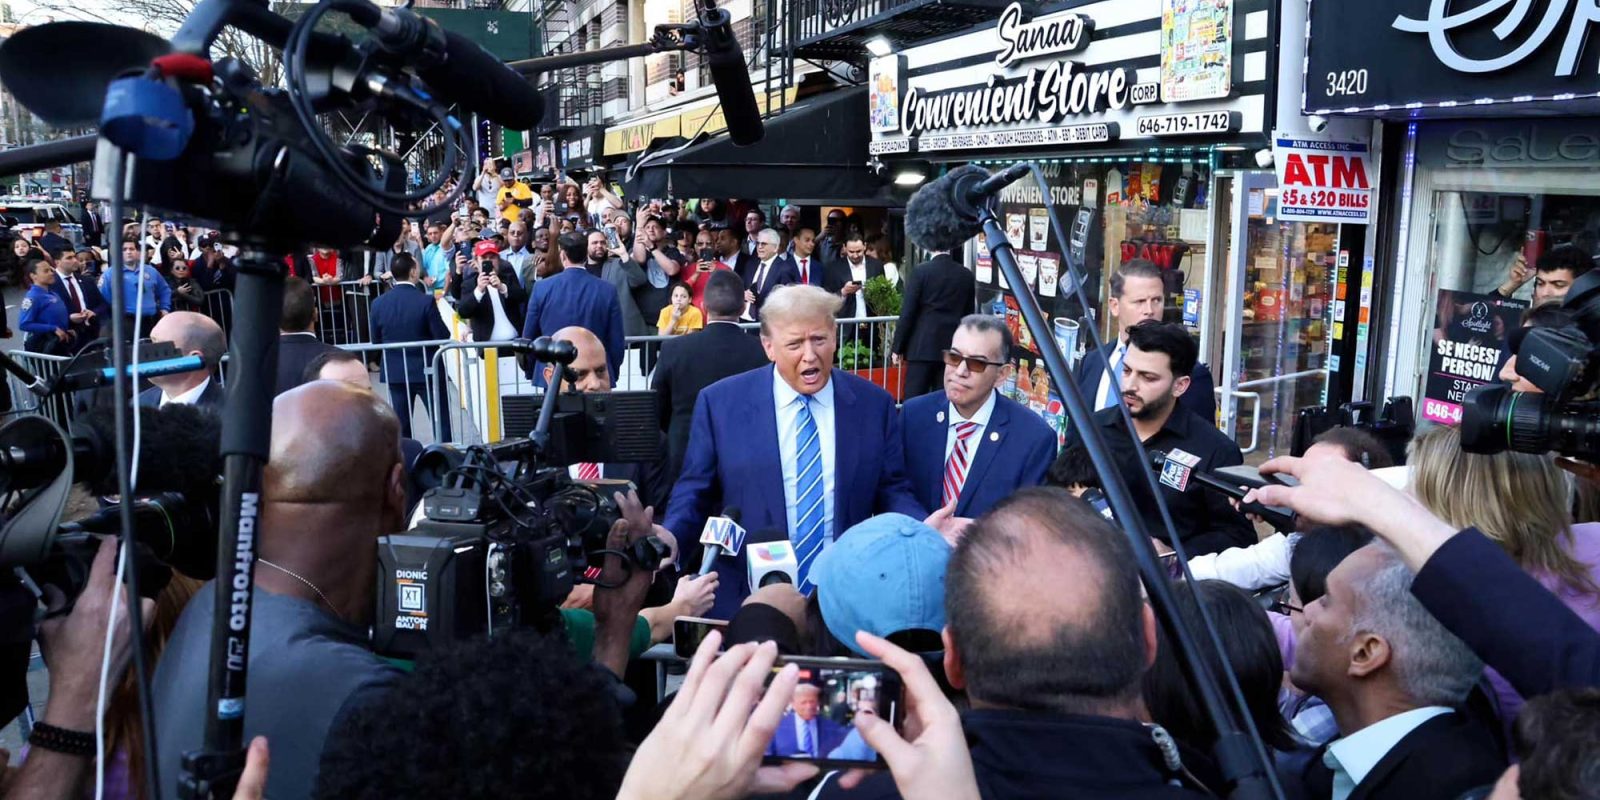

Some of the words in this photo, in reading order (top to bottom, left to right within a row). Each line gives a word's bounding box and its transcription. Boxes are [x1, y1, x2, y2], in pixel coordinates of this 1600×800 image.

[998, 3, 1080, 65] Sanaa
[1326, 69, 1368, 97] 3420
[902, 75, 1038, 136] Convenient
[1039, 61, 1127, 122] Store
[1133, 86, 1157, 101] CORP.
[1139, 114, 1228, 134] 646-719-1742
[976, 134, 990, 146] CANDY
[1014, 130, 1044, 143] ACCESSORIES
[1048, 129, 1058, 142] ATM
[1062, 128, 1071, 141] EBT
[1075, 126, 1090, 140] DEBIT
[1091, 125, 1107, 140] CARD
[1292, 140, 1308, 148] ATM
[1309, 141, 1336, 150] ACCESS
[881, 140, 909, 152] BROADWAY
[1283, 153, 1369, 189] ATM
[999, 187, 1043, 204] ONVENIEN
[1050, 187, 1080, 206] STORE
[1282, 189, 1298, 206] $5
[1300, 194, 1307, 206] &
[1310, 190, 1337, 207] $20
[1339, 193, 1368, 208] BILLS
[1121, 243, 1174, 269] RAW
[1437, 339, 1453, 356] SE
[1441, 356, 1496, 382] PERSON
[229, 492, 258, 632] Manfrotto
[396, 570, 428, 580] DIONIC
[405, 589, 419, 601] XT
[395, 622, 427, 630] BAUER
